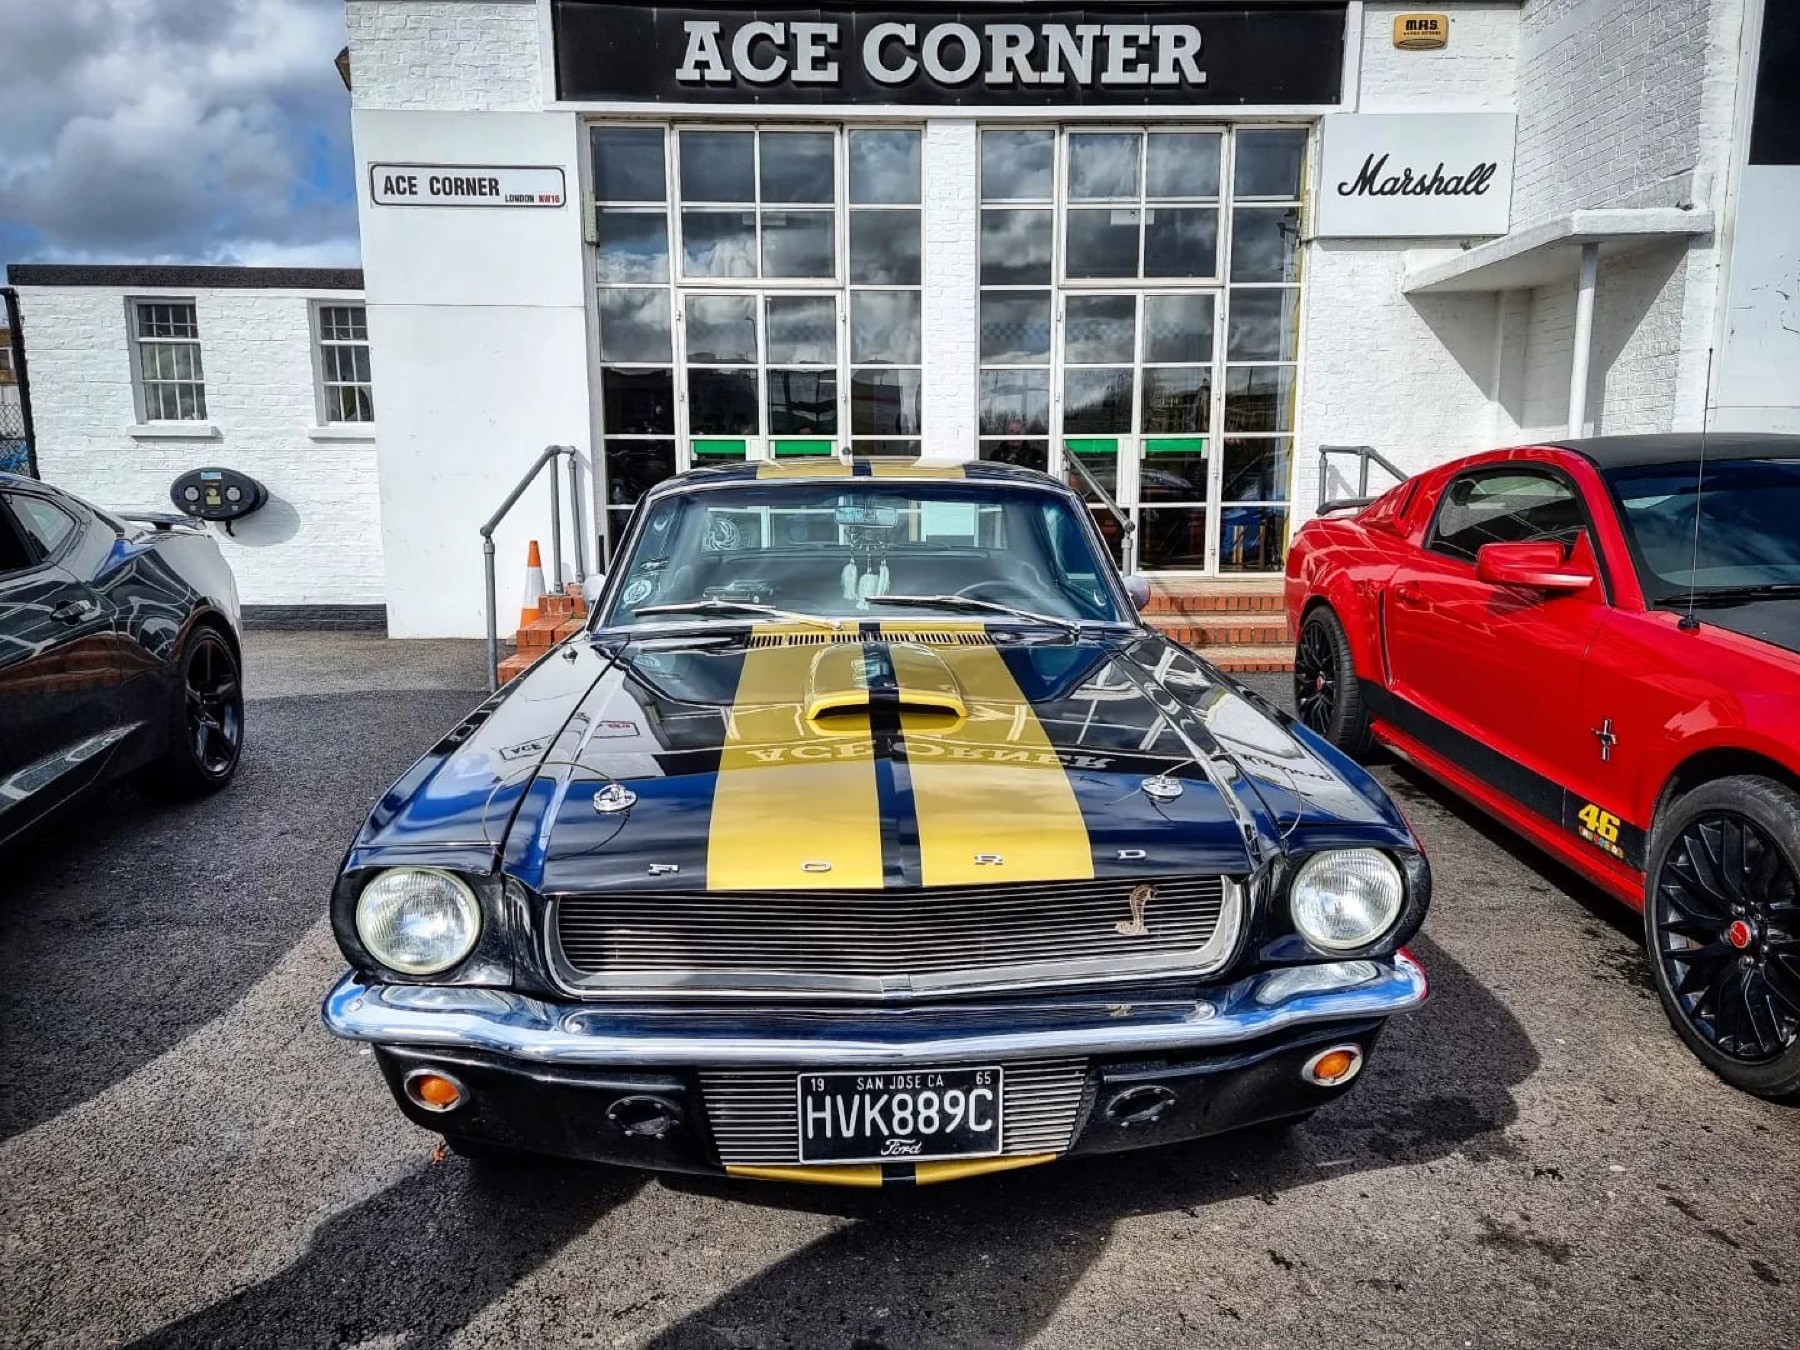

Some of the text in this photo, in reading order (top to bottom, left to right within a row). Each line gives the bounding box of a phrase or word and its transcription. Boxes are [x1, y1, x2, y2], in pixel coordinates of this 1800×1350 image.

[675, 20, 1207, 86] ACE CORNER
[1337, 153, 1498, 196] Marshall
[383, 175, 500, 197] ACE CORNER
[504, 194, 561, 203] LONDON NW10
[1578, 803, 1621, 843] 46
[810, 1077, 825, 1092] 19
[856, 1074, 945, 1091] SAN JOSE CA
[975, 1071, 992, 1086] 65
[806, 1088, 994, 1140] HVK889C
[880, 1138, 922, 1156] Ford
